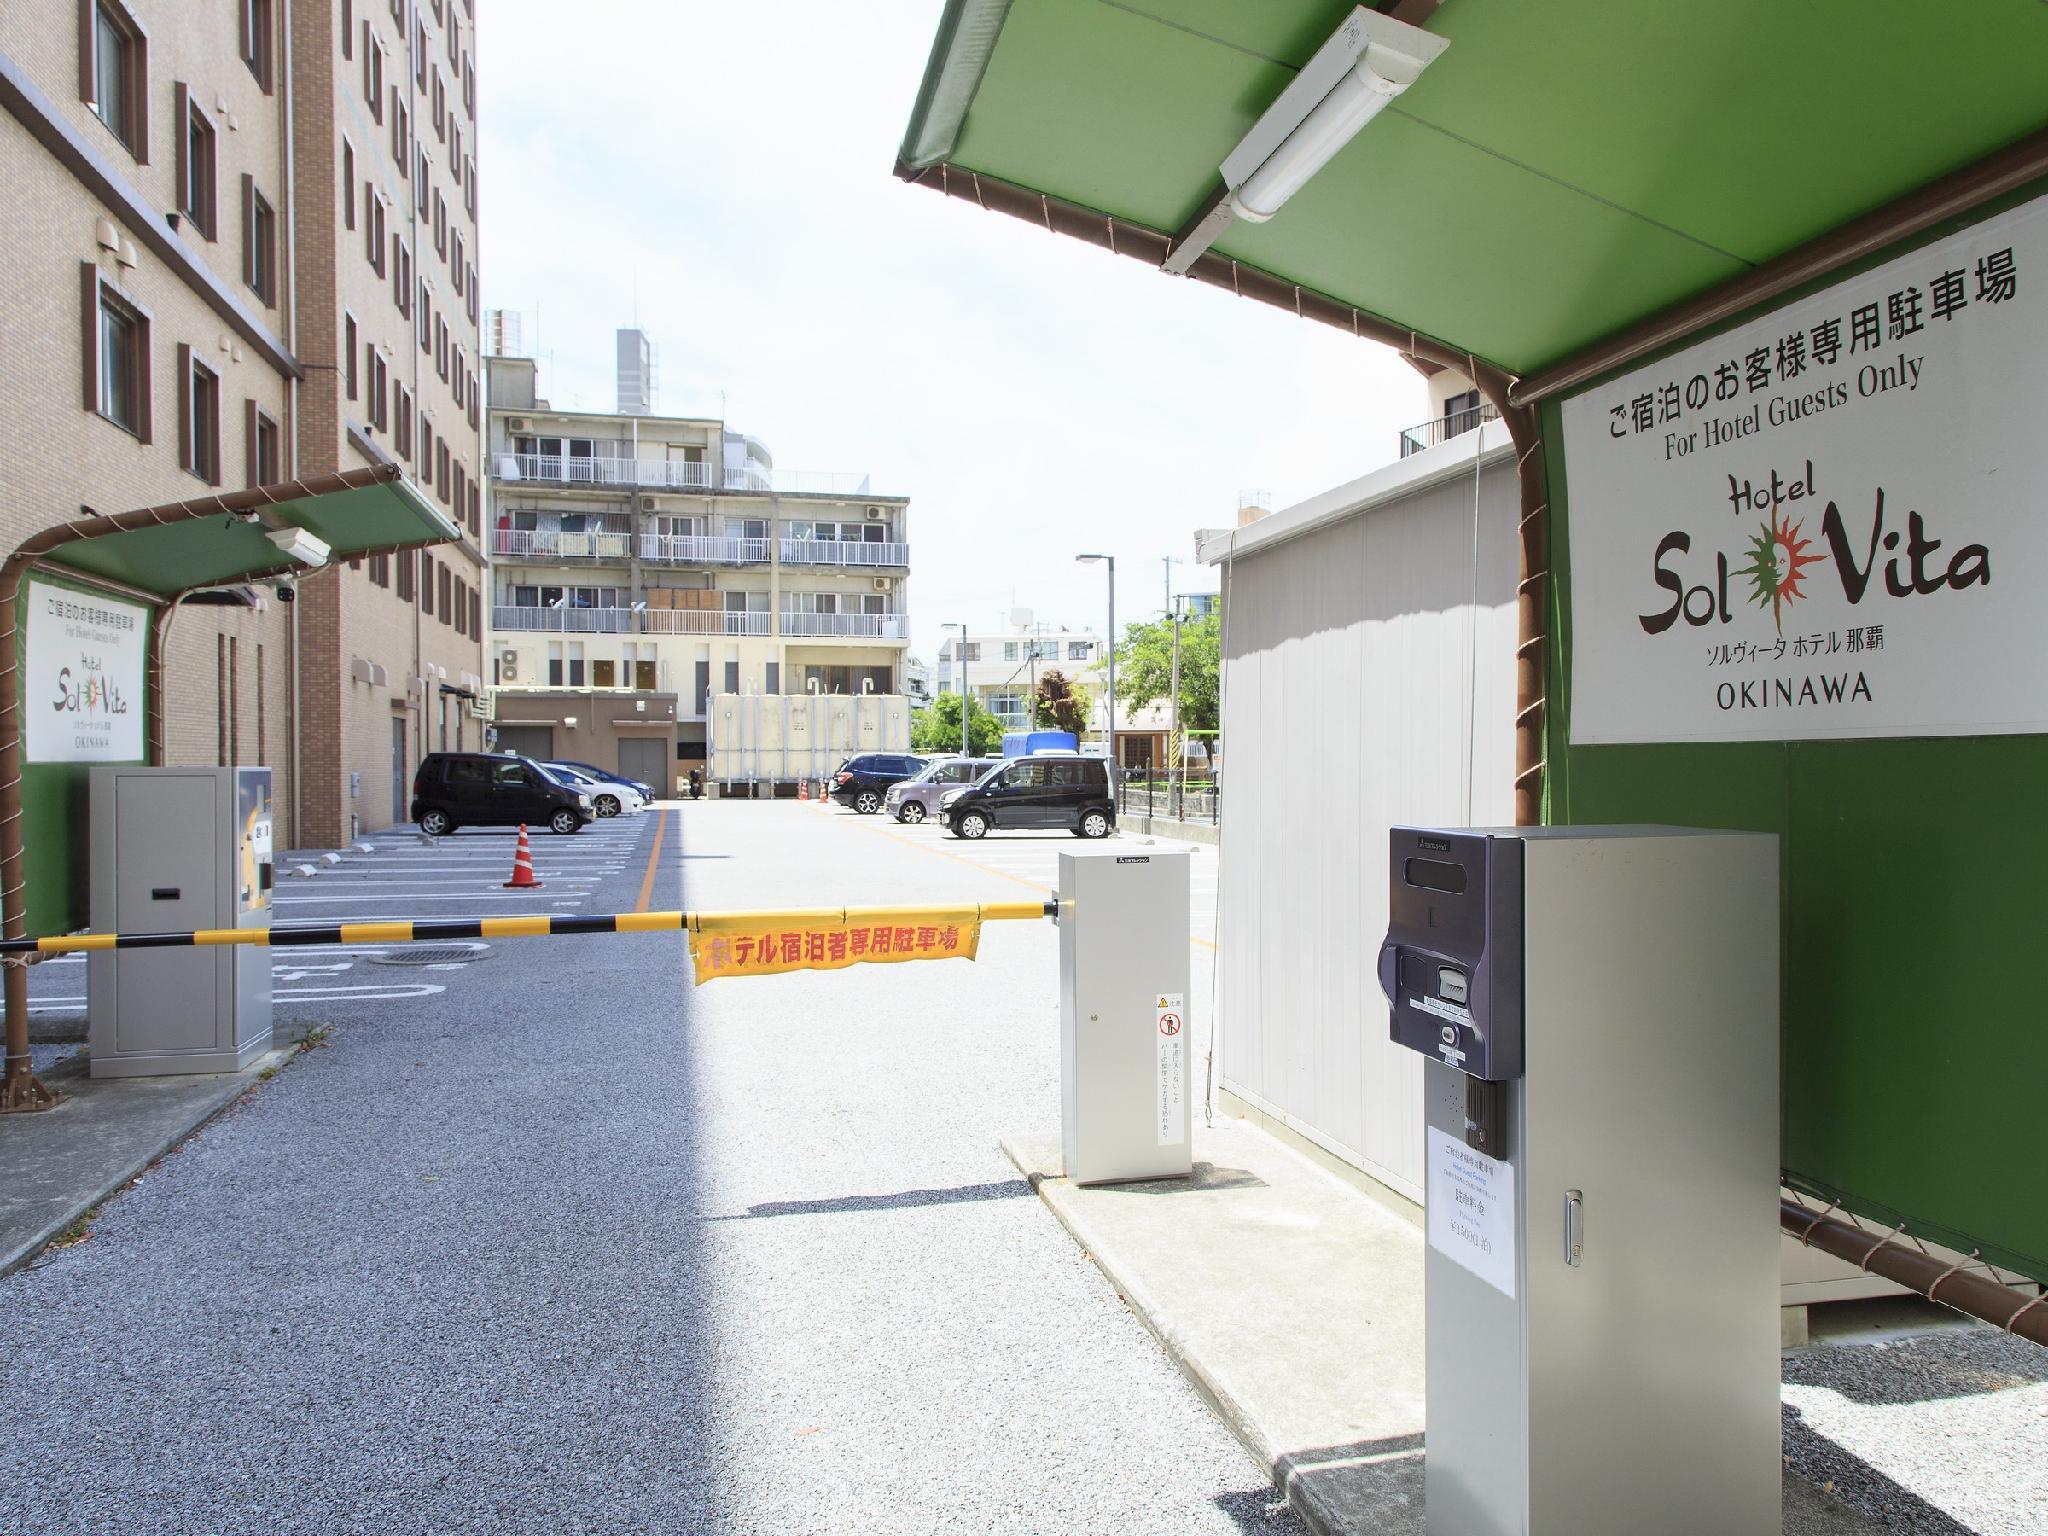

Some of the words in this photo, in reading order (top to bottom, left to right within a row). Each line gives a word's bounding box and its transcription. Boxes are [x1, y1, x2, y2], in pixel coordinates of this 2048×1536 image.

[1609, 246, 2017, 440] ご宿泊のお客様専用駐車場
[1665, 431, 1698, 460] For
[1703, 402, 1761, 448] Hotel
[1768, 379, 1849, 429] Guests
[1857, 351, 1925, 400] Only
[1728, 459, 1817, 515] Hotel
[1638, 531, 1733, 635] Sol
[1821, 487, 1991, 605] Vita
[81, 651, 102, 671] Hotel
[1707, 639, 1787, 666] ソルヴィータ
[1793, 631, 1842, 657] ホテル
[1846, 624, 1886, 653] 那覇
[53, 667, 81, 713] Sol
[102, 675, 127, 714] Vita
[1716, 671, 1873, 711] OKINAWA
[75, 735, 109, 749] OKINAWA
